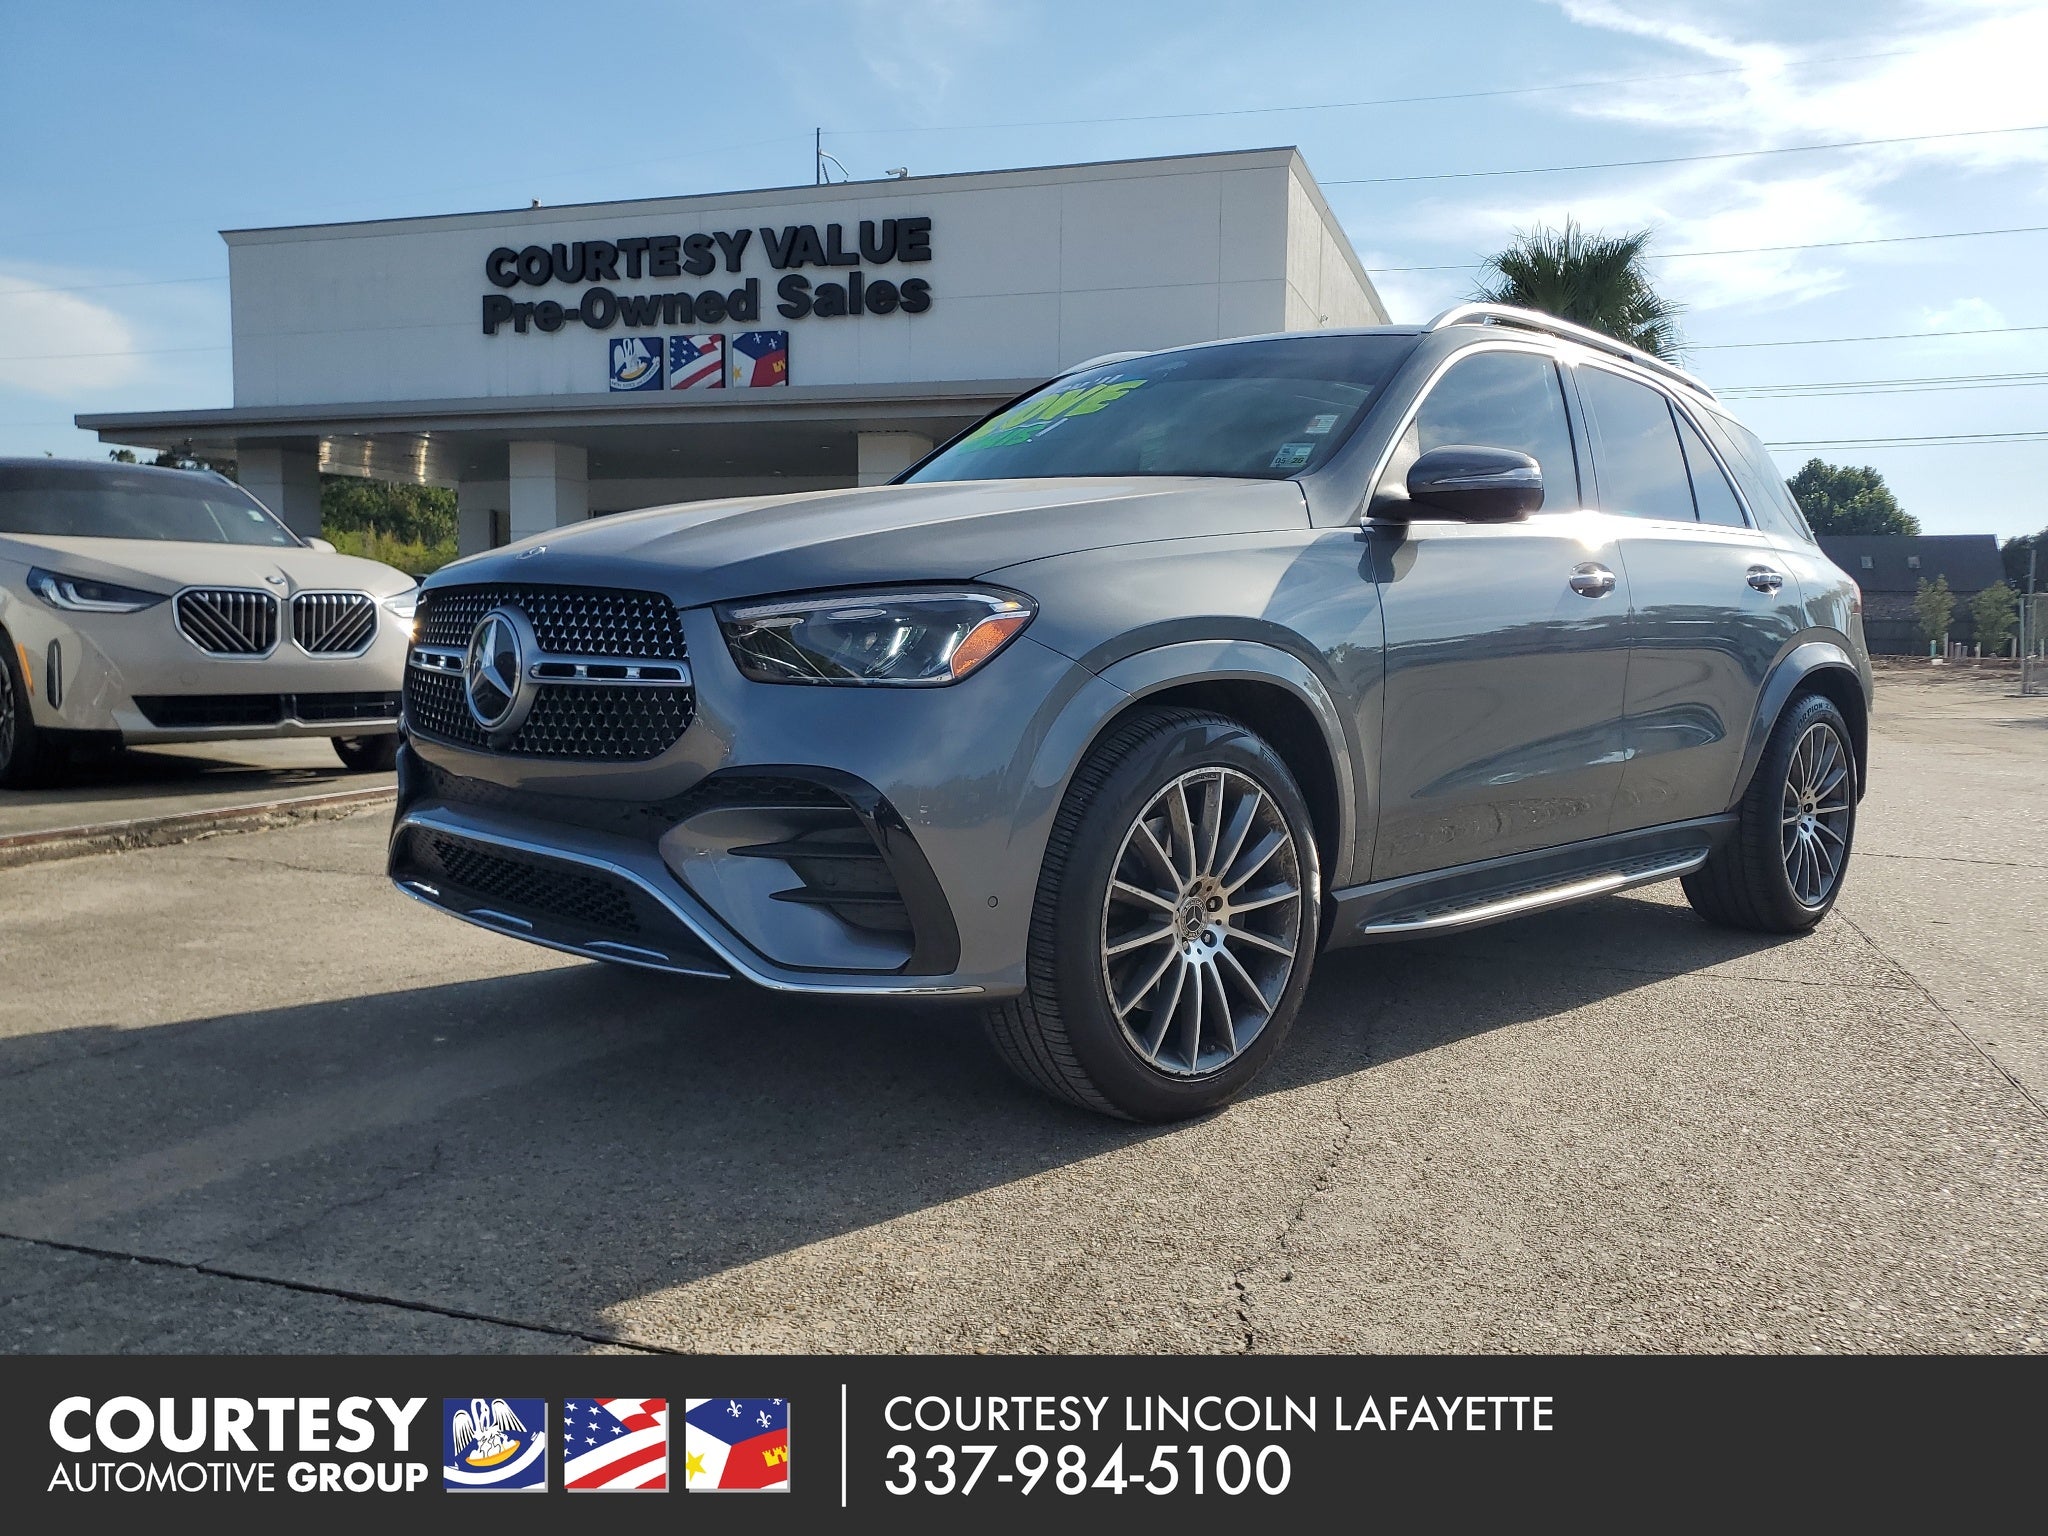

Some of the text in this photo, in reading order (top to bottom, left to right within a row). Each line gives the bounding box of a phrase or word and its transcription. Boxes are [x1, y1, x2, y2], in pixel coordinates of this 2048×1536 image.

[485, 217, 932, 288] COURTESY VALUE
[482, 271, 933, 335] Pre-Owned Sales
